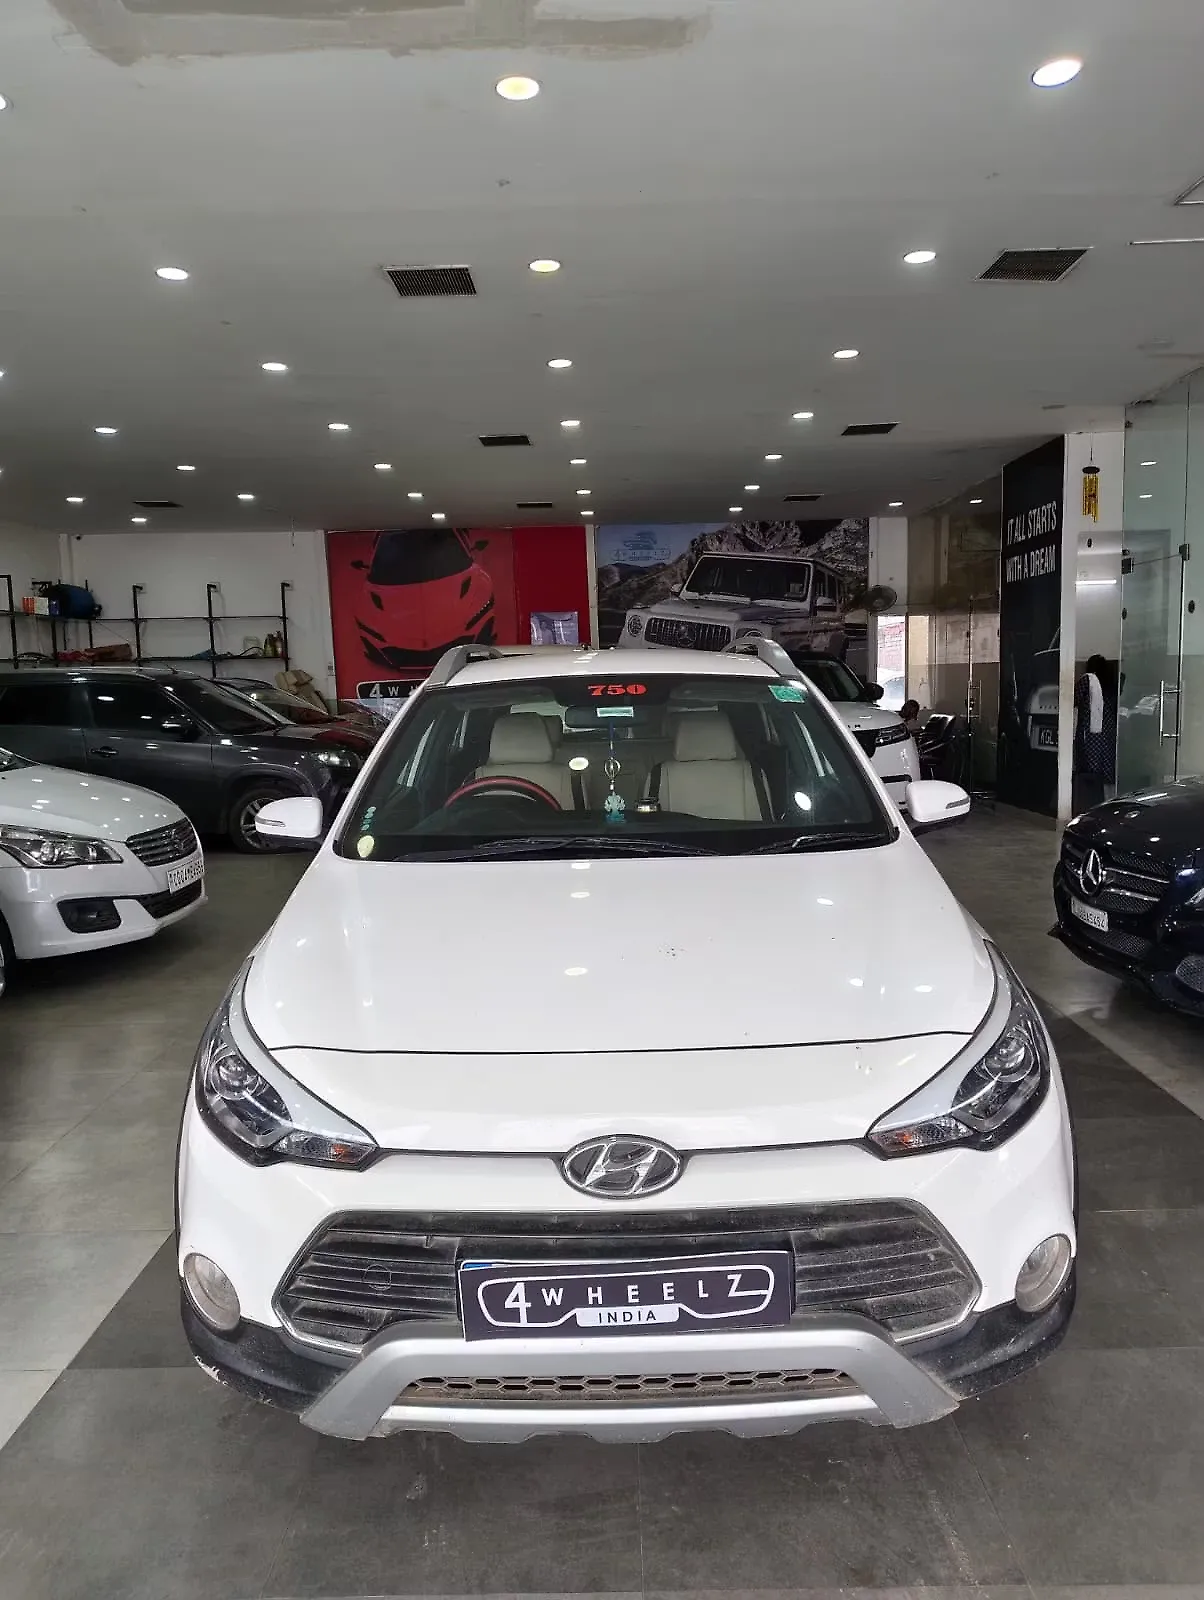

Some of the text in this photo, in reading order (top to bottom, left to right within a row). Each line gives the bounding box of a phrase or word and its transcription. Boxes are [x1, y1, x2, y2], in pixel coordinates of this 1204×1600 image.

[1007, 501, 1057, 545] IT ALL STARTS
[1006, 544, 1056, 583] WITH A DREAM
[588, 683, 648, 696] 750
[598, 1311, 657, 1325] INDIA
